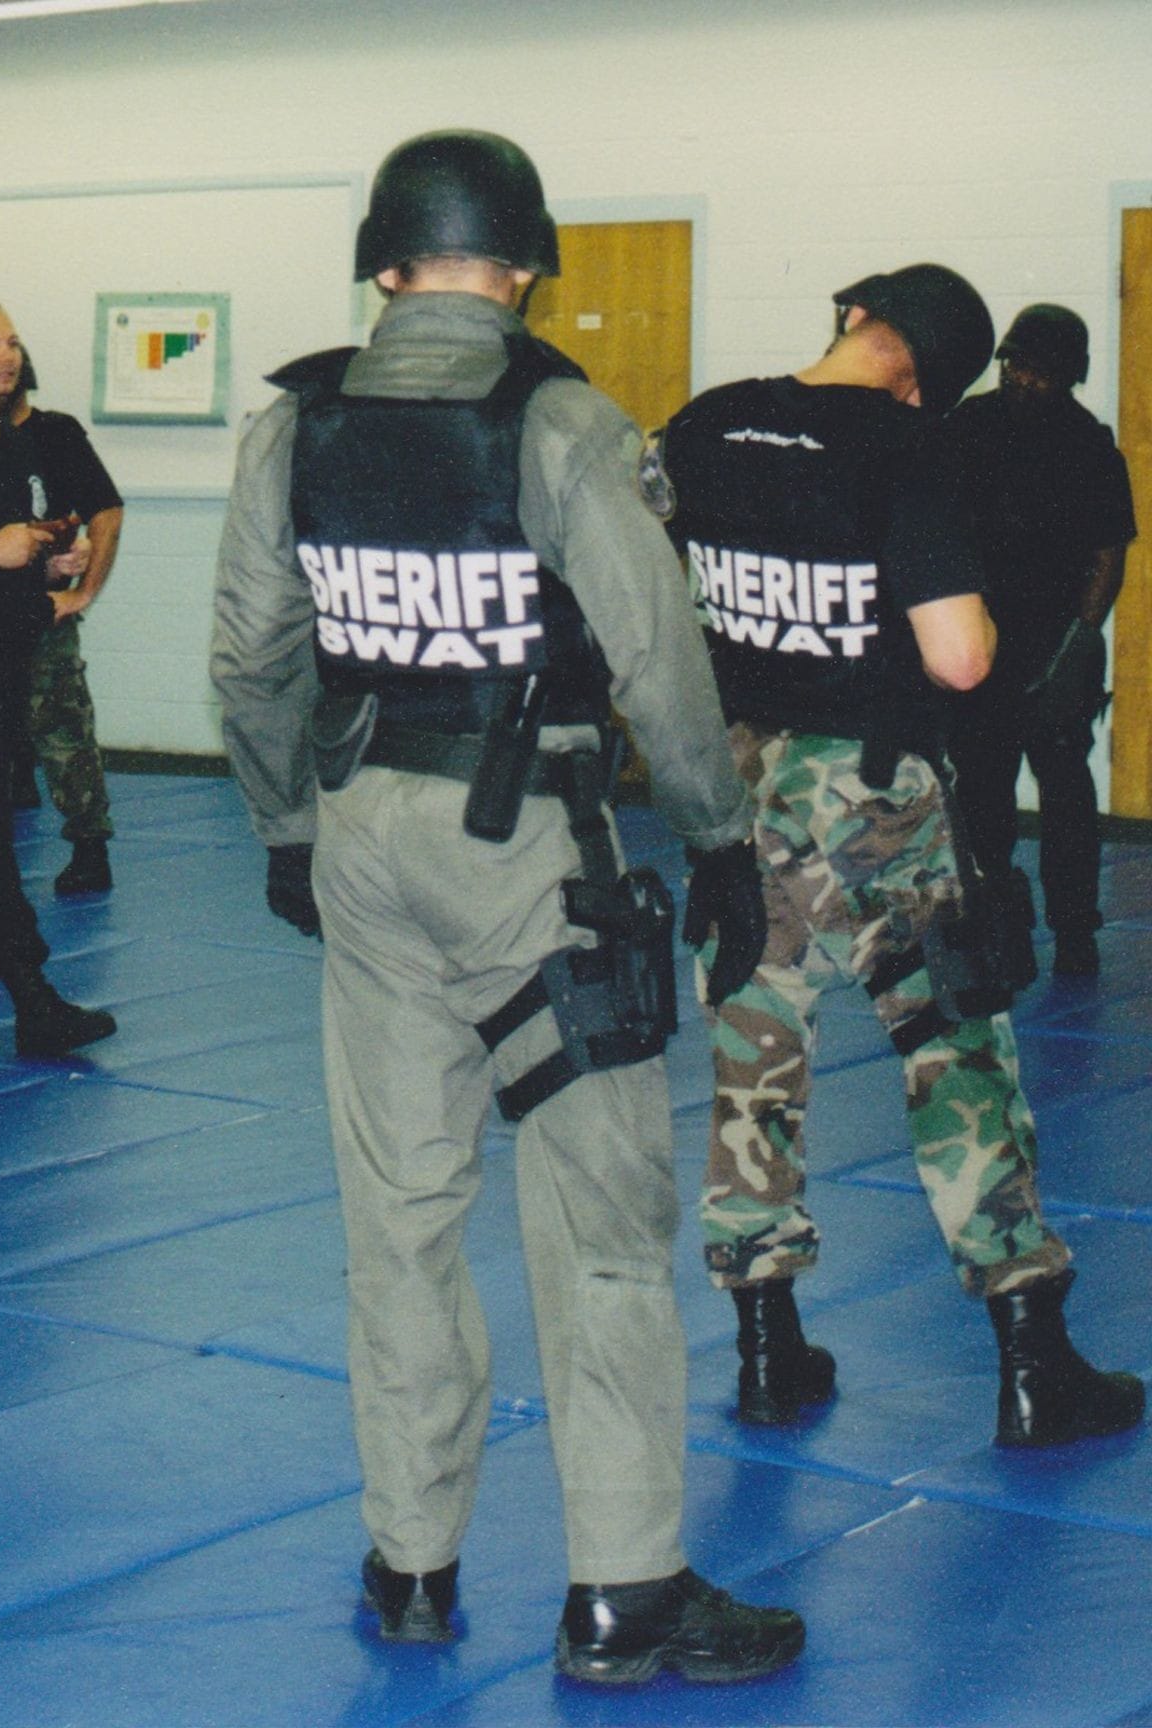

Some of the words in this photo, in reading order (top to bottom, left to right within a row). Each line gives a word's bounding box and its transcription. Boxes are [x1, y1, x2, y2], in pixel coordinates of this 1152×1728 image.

[297, 543, 539, 629] SHERIFF
[687, 540, 878, 624] SHERIFF
[316, 615, 544, 669] SWAT
